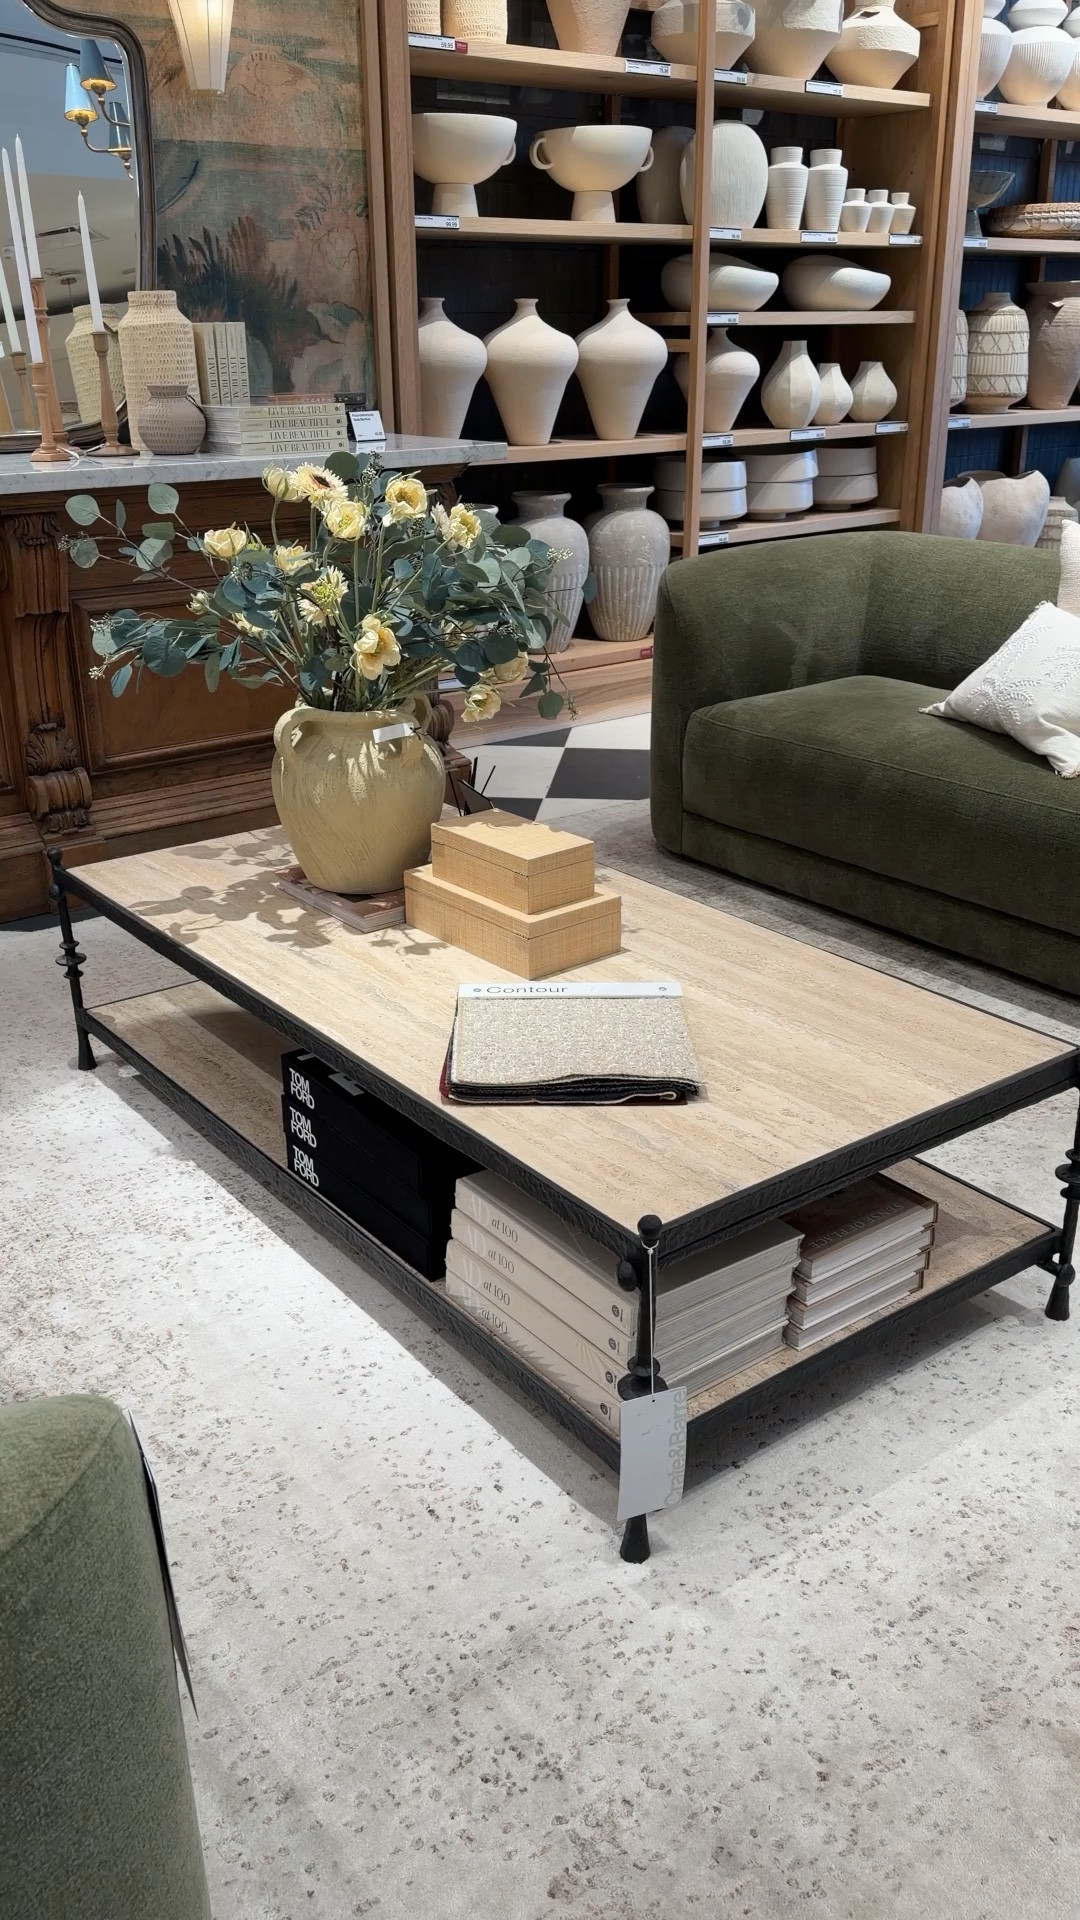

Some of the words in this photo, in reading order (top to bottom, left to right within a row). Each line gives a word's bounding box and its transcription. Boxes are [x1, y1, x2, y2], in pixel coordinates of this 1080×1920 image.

[207, 357, 216, 377] LIVE
[219, 357, 228, 377] LIVE
[239, 357, 247, 377] LIVE
[268, 406, 287, 416] LIVE
[287, 405, 329, 415] BEAUTIFUL
[269, 419, 288, 429] LIVE
[288, 418, 331, 428] BEAUTIFUL
[270, 431, 289, 441] LIVE
[289, 430, 332, 439] BEAUTIFUL
[272, 443, 290, 453] LIVE
[291, 442, 333, 452] BEAUTIFUL
[486, 986, 568, 994] Contour
[289, 1067, 310, 1094] TOM
[290, 1081, 315, 1109] FORD
[289, 1106, 312, 1133] TOM
[291, 1119, 317, 1148] FORD
[293, 1145, 314, 1171] TOM
[294, 1158, 319, 1187] FORD
[866, 1203, 904, 1223] SENSE
[491, 1218, 500, 1230] at
[502, 1222, 518, 1243] 100
[849, 1221, 865, 1231] OF
[809, 1228, 849, 1249] PLACE
[488, 1248, 496, 1260] at
[498, 1253, 515, 1274] 100
[483, 1281, 492, 1293] at
[493, 1285, 510, 1306] 100
[481, 1308, 491, 1321] at
[491, 1313, 508, 1335] 100
